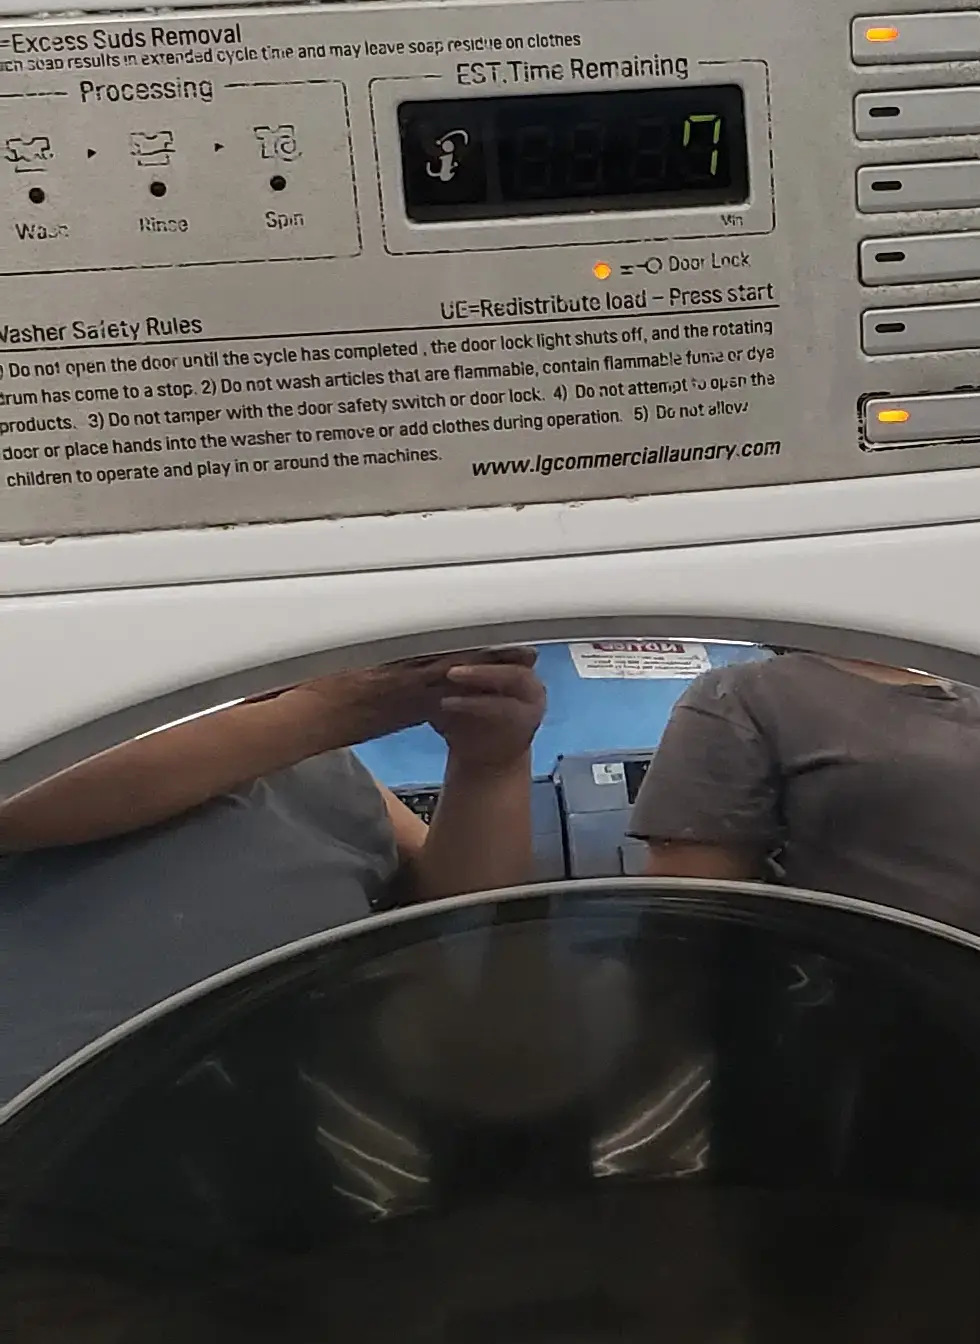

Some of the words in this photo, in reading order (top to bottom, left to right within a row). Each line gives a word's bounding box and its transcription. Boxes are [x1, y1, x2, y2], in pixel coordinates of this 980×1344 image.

[0, 33, 88, 53] =Excess
[92, 27, 146, 49] Suds
[150, 22, 241, 47] Removal
[216, 46, 258, 65] cycle
[298, 44, 325, 58] and
[329, 44, 361, 58] may
[364, 40, 404, 55] leave
[408, 40, 443, 56] soap
[505, 37, 523, 49] on
[456, 60, 563, 85] EST.Time
[570, 55, 688, 79] Remaining
[79, 76, 212, 102] Processing
[682, 114, 721, 176] 7
[605, 289, 646, 310] load
[669, 287, 722, 306] Press
[727, 282, 773, 302] start
[145, 316, 202, 335] Rules
[8, 362, 30, 377] Do
[33, 361, 60, 376] not
[65, 360, 106, 377] open
[110, 357, 137, 372] the
[141, 355, 178, 370] door
[182, 351, 218, 368] until
[222, 350, 249, 365] the
[253, 347, 297, 366] cycle
[300, 346, 330, 361] has
[334, 340, 417, 360] completed
[430, 339, 456, 354] the
[460, 337, 496, 352] door
[500, 333, 533, 350] lock
[536, 332, 571, 350] light
[574, 329, 618, 345] shuts
[621, 326, 647, 343] off,
[651, 324, 679, 340] and
[683, 323, 708, 338] the
[712, 321, 772, 336] rotating
[40, 388, 71, 403] has
[74, 387, 118, 401] come
[122, 384, 139, 398] to
[143, 385, 153, 397] a
[200, 378, 216, 396] 2)
[220, 378, 241, 393] Do
[245, 376, 272, 391] not
[275, 373, 320, 390] wash
[324, 370, 384, 387] articles
[387, 368, 420, 383] that
[424, 368, 449, 381] are
[542, 356, 599, 374] contain
[727, 349, 743, 361] or
[0, 416, 76, 436] products.
[87, 411, 104, 430] 3)
[108, 411, 129, 426] Do
[133, 411, 160, 425] not
[163, 408, 221, 425] tamper
[225, 403, 262, 420] with
[266, 402, 293, 417] the
[297, 400, 333, 415] door
[337, 397, 387, 414] safety
[391, 392, 445, 410] switch
[449, 394, 466, 406] or
[469, 390, 505, 405] door
[508, 386, 545, 402] lock.
[553, 384, 567, 401] 4)
[575, 384, 594, 398] Do
[599, 382, 625, 397] not
[750, 371, 775, 386] the
[2, 445, 39, 460] door
[43, 445, 60, 457] or
[64, 441, 108, 459] place
[112, 437, 162, 453] hands
[165, 435, 196, 450] into
[199, 433, 227, 448] the
[230, 429, 292, 446] washer
[295, 429, 312, 442] to
[315, 426, 374, 441] remove
[378, 425, 394, 437] or
[399, 420, 428, 436] add
[432, 418, 489, 434] clothes
[493, 414, 542, 430] during
[546, 409, 622, 429] operation.
[634, 404, 648, 422] 5)
[656, 404, 675, 419] Do
[679, 403, 704, 418] not
[6, 470, 72, 487] children
[75, 469, 92, 482] to
[96, 465, 159, 484] operate
[163, 461, 192, 477] and
[197, 460, 230, 478] play
[234, 458, 248, 472] in
[252, 459, 269, 471] or
[273, 452, 329, 470] around
[332, 452, 359, 466] the
[362, 447, 442, 464] machines.
